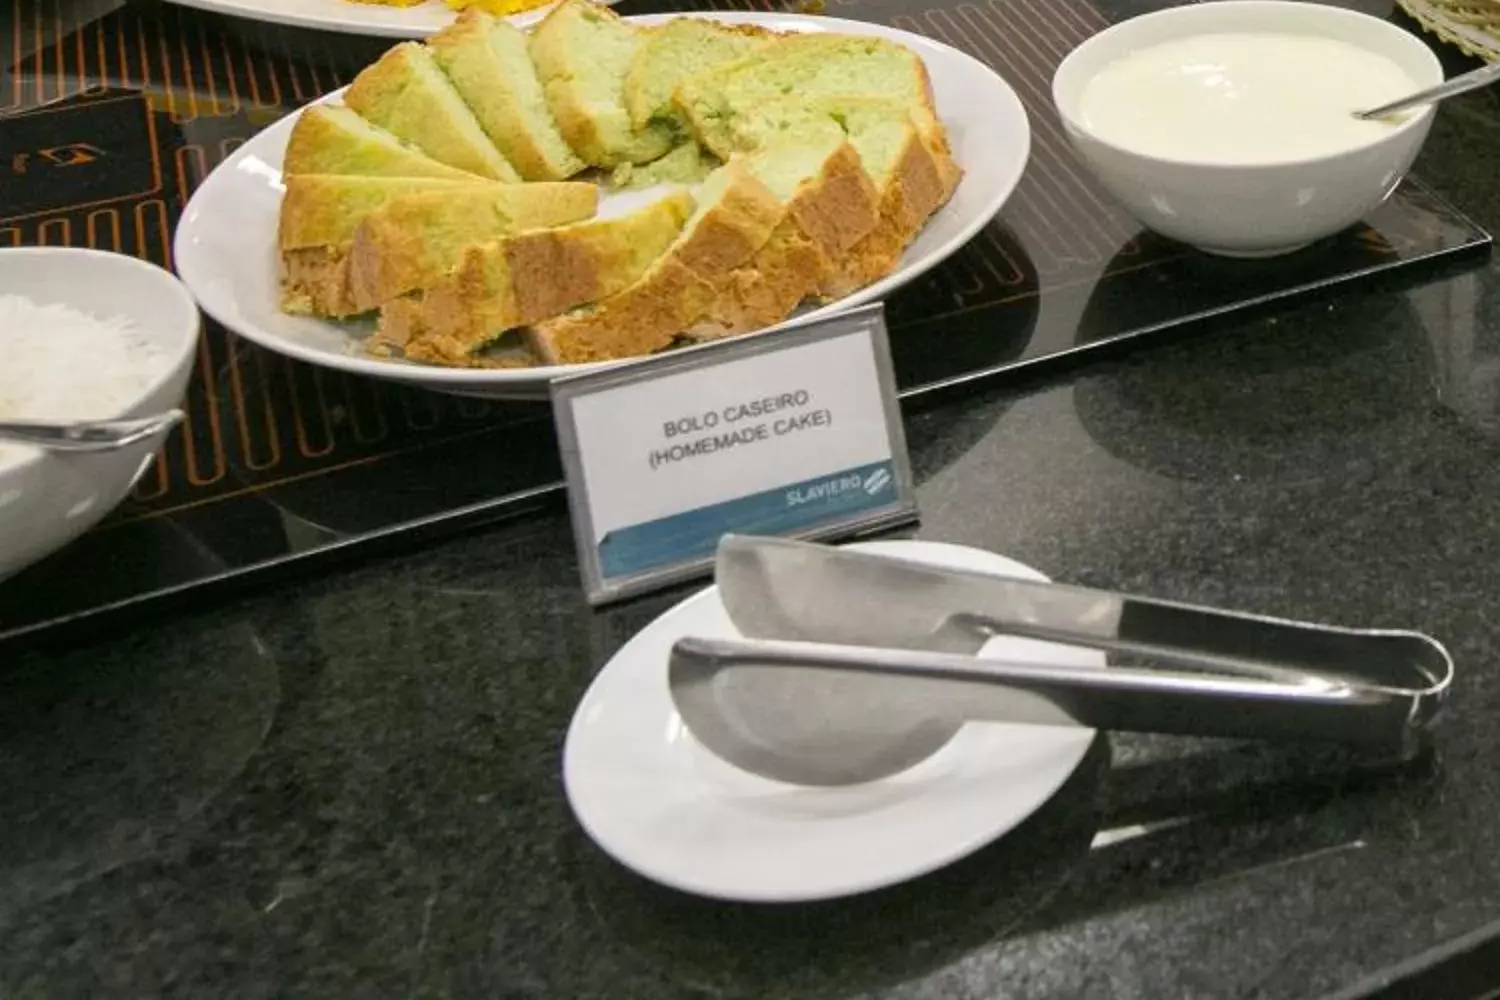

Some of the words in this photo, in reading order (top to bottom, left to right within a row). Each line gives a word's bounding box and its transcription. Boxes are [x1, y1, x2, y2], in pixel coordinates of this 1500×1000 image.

[663, 409, 719, 438] BOLO
[722, 389, 810, 424] CASEIRO
[648, 427, 769, 471] (HOMEMADE
[773, 408, 833, 437] CAKE)
[786, 474, 861, 506] SLAVIERO
